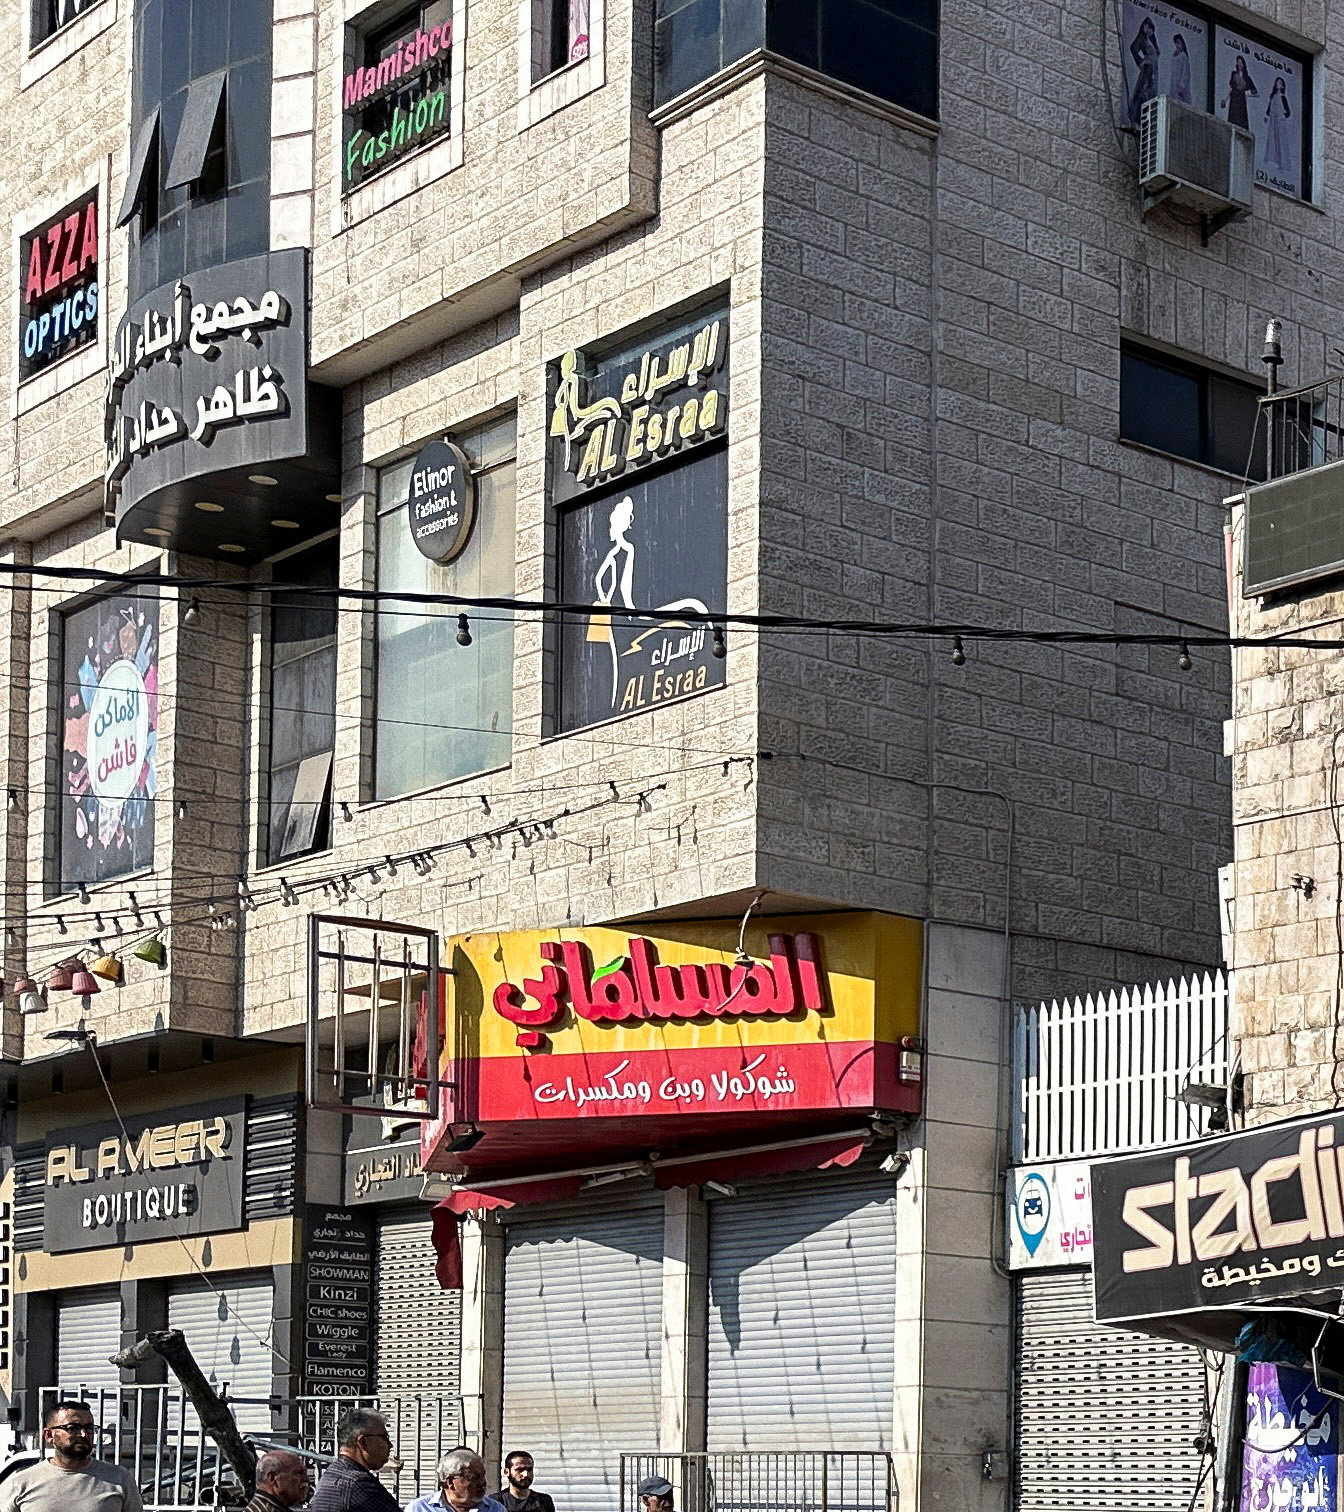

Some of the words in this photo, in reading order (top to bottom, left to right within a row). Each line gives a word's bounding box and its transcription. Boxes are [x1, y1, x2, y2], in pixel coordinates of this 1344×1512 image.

[346, 90, 446, 181] Fashion
[25, 201, 98, 304] AZZA
[24, 282, 98, 359] OPTICS
[188, 290, 281, 355] مجمع
[188, 364, 280, 441] ظاهر
[576, 418, 617, 483] AL
[626, 390, 719, 462] Esraa
[414, 465, 456, 498] Elinor
[620, 674, 646, 712] AL
[651, 665, 707, 702] Esraa
[534, 1059, 652, 1104] ومكسرات
[82, 1183, 189, 1228] BOUTIQUE
[309, 1266, 369, 1280] SHOWMAN
[320, 1285, 358, 1301] Kinzi
[309, 1306, 337, 1318] CHIC
[337, 1308, 368, 1319] shoes
[316, 1324, 360, 1339] Wiggle
[318, 1341, 357, 1352] Everest
[308, 1363, 367, 1378] Flamenco
[313, 1384, 361, 1396] KOTON
